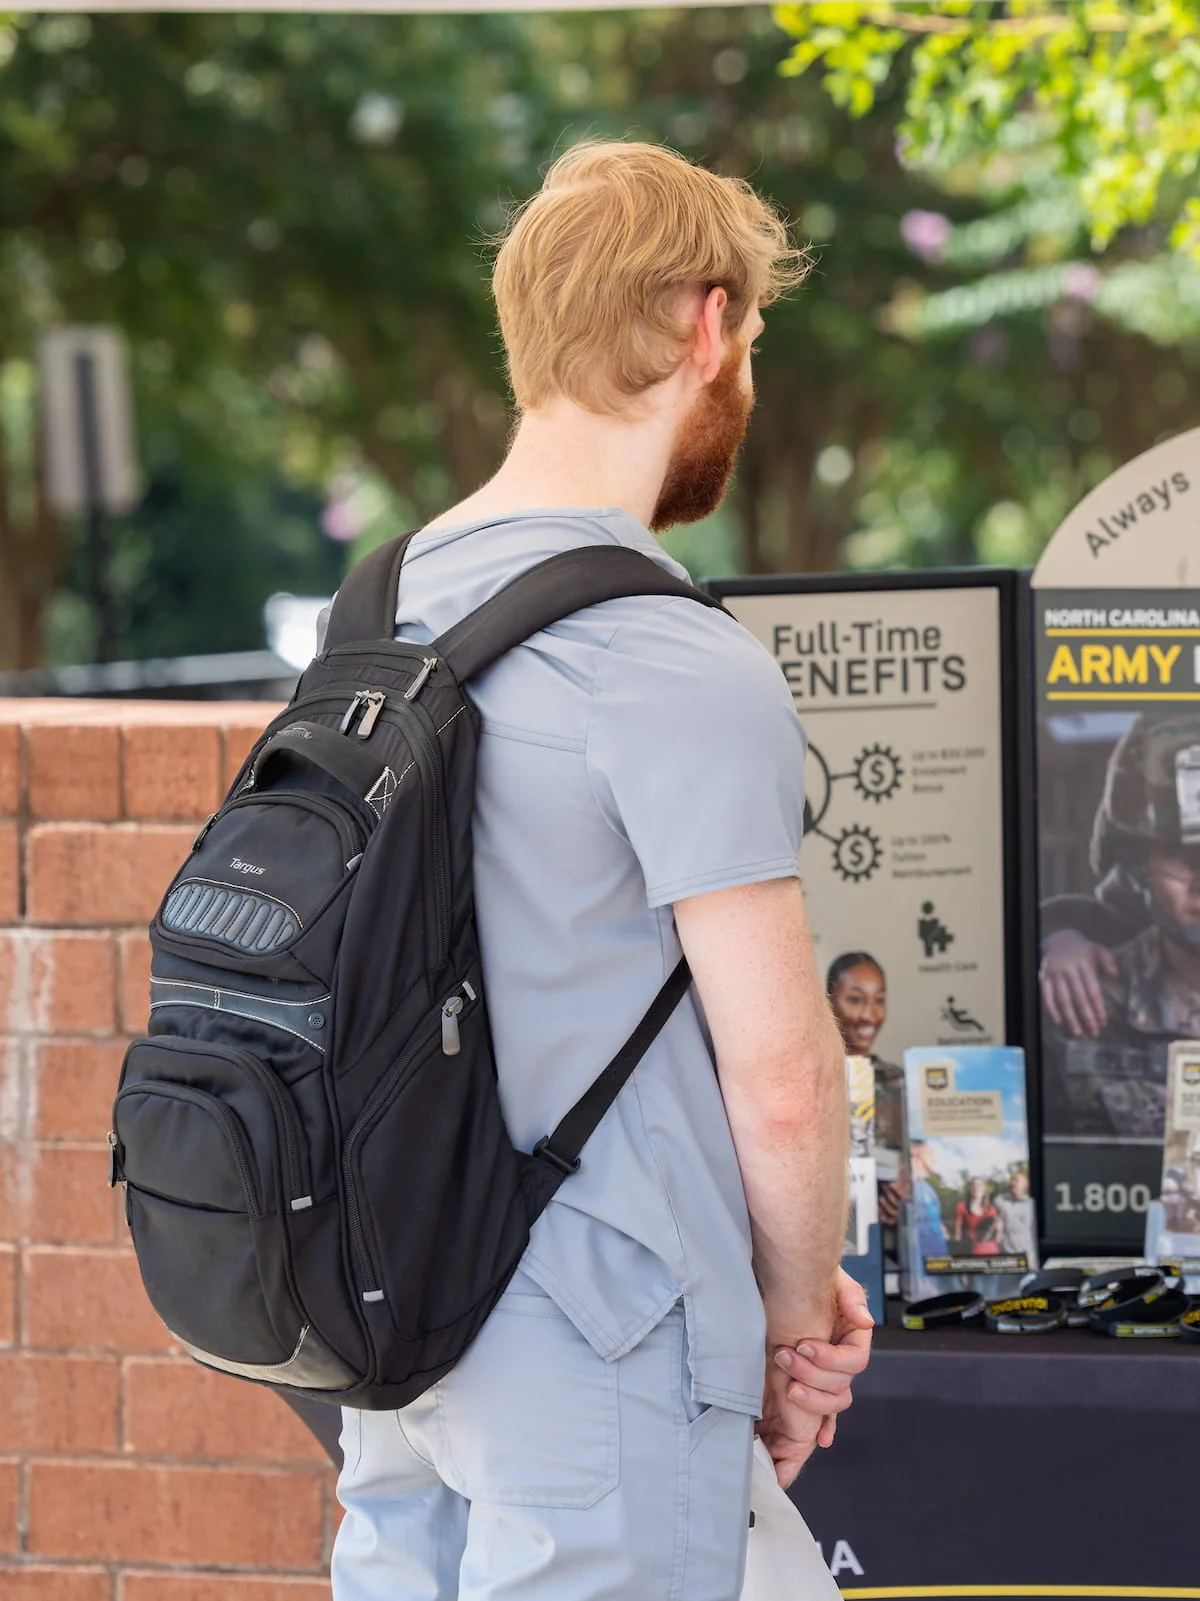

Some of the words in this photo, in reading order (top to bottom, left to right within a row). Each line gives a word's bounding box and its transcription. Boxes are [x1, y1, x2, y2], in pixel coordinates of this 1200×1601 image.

[1083, 470, 1191, 559] Always
[1045, 609, 1106, 628] NORTH
[1109, 609, 1200, 628] CAROLINA
[773, 619, 942, 657] Full-Time
[781, 655, 968, 699] ENEFITS
[1046, 644, 1182, 685] ARMY
[229, 857, 267, 876] Targus
[1053, 1181, 1151, 1214] 1.800
